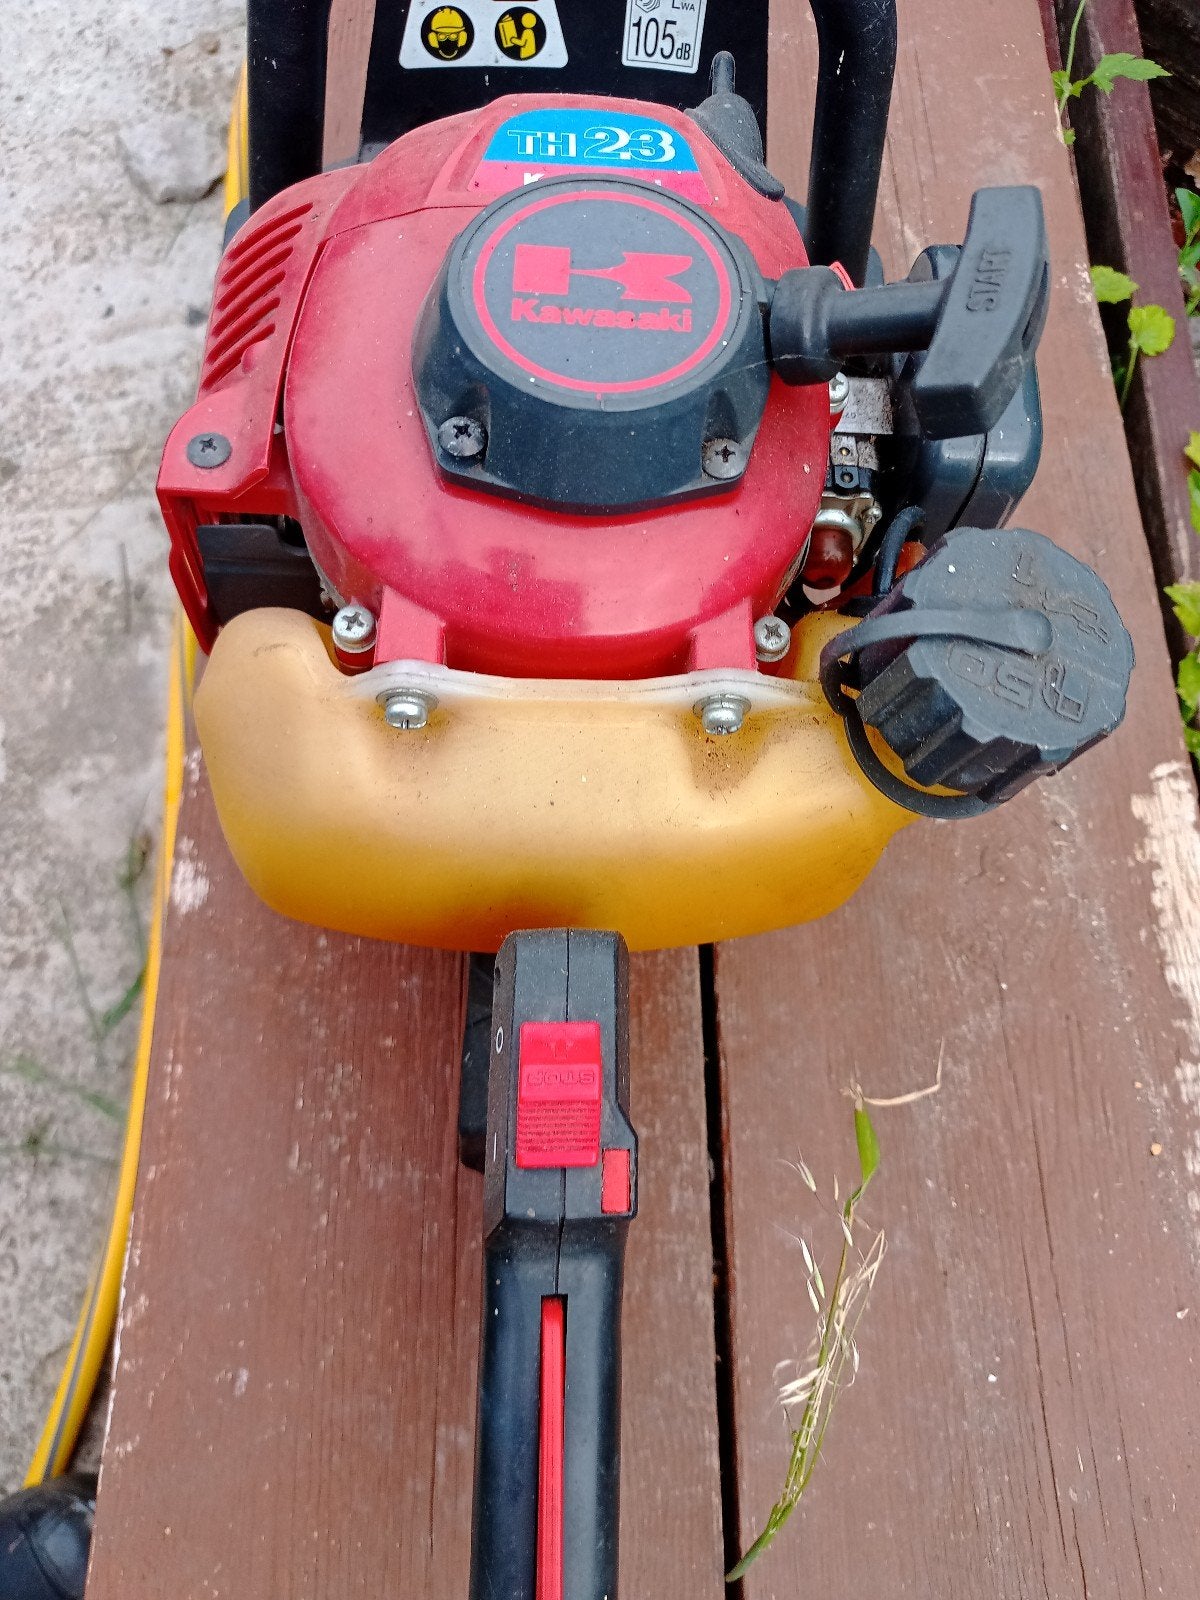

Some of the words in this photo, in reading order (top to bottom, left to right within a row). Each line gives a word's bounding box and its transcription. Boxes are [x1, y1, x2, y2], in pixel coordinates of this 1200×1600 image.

[507, 129, 577, 158] TH
[966, 248, 1012, 312] START
[510, 297, 693, 333] Kawasaki
[526, 1069, 595, 1087] STOP
